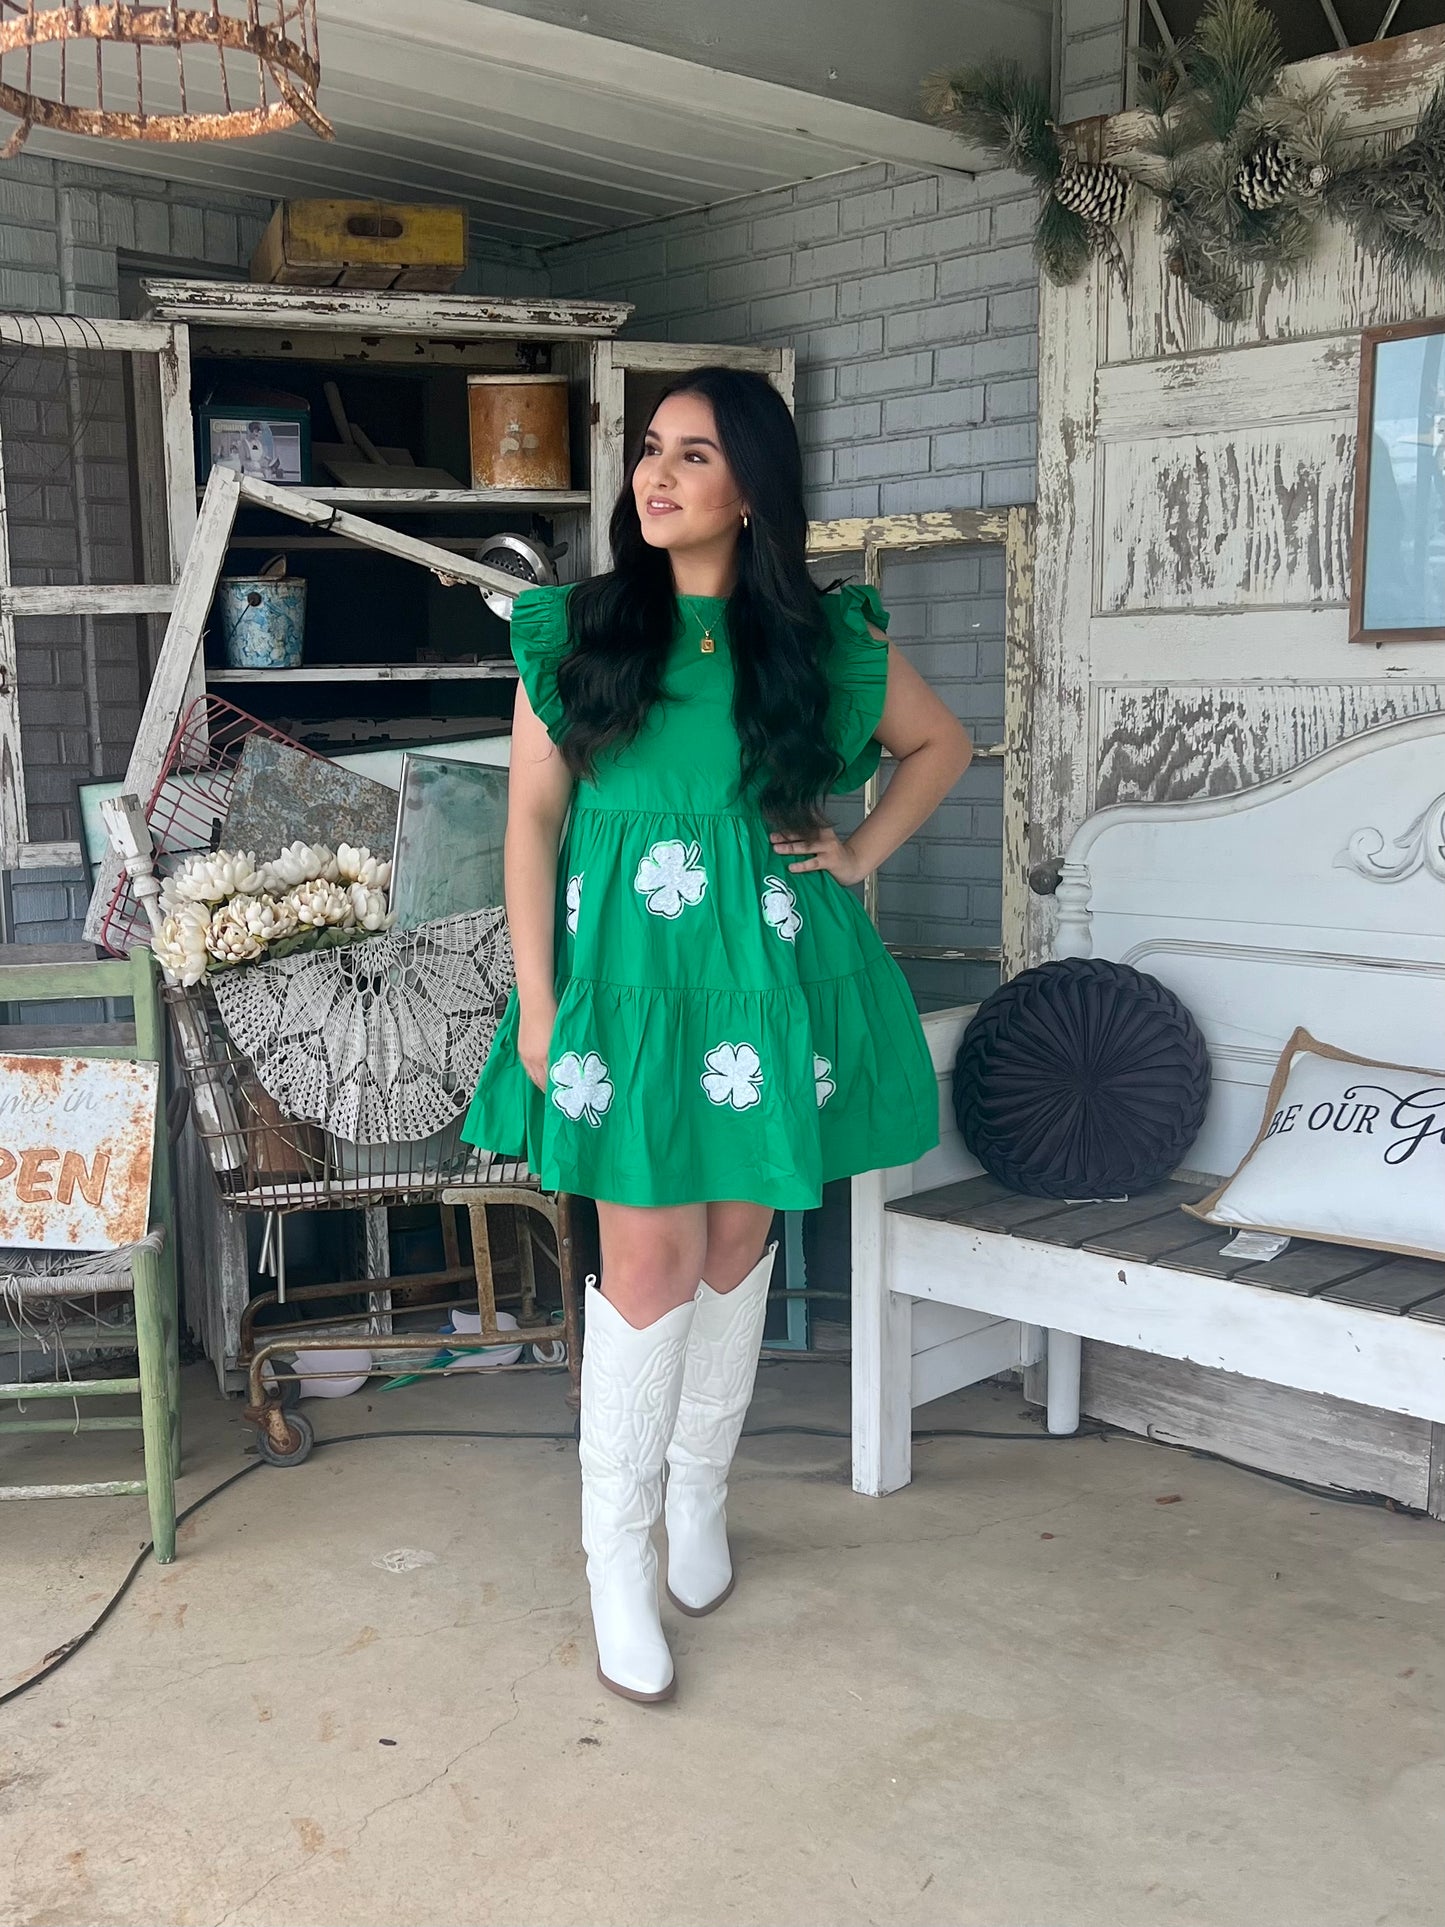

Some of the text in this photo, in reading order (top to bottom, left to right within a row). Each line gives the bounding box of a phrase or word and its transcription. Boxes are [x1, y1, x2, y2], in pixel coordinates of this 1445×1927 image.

[63, 1088, 98, 1113] in
[1264, 1085, 1445, 1165] BE OUR G
